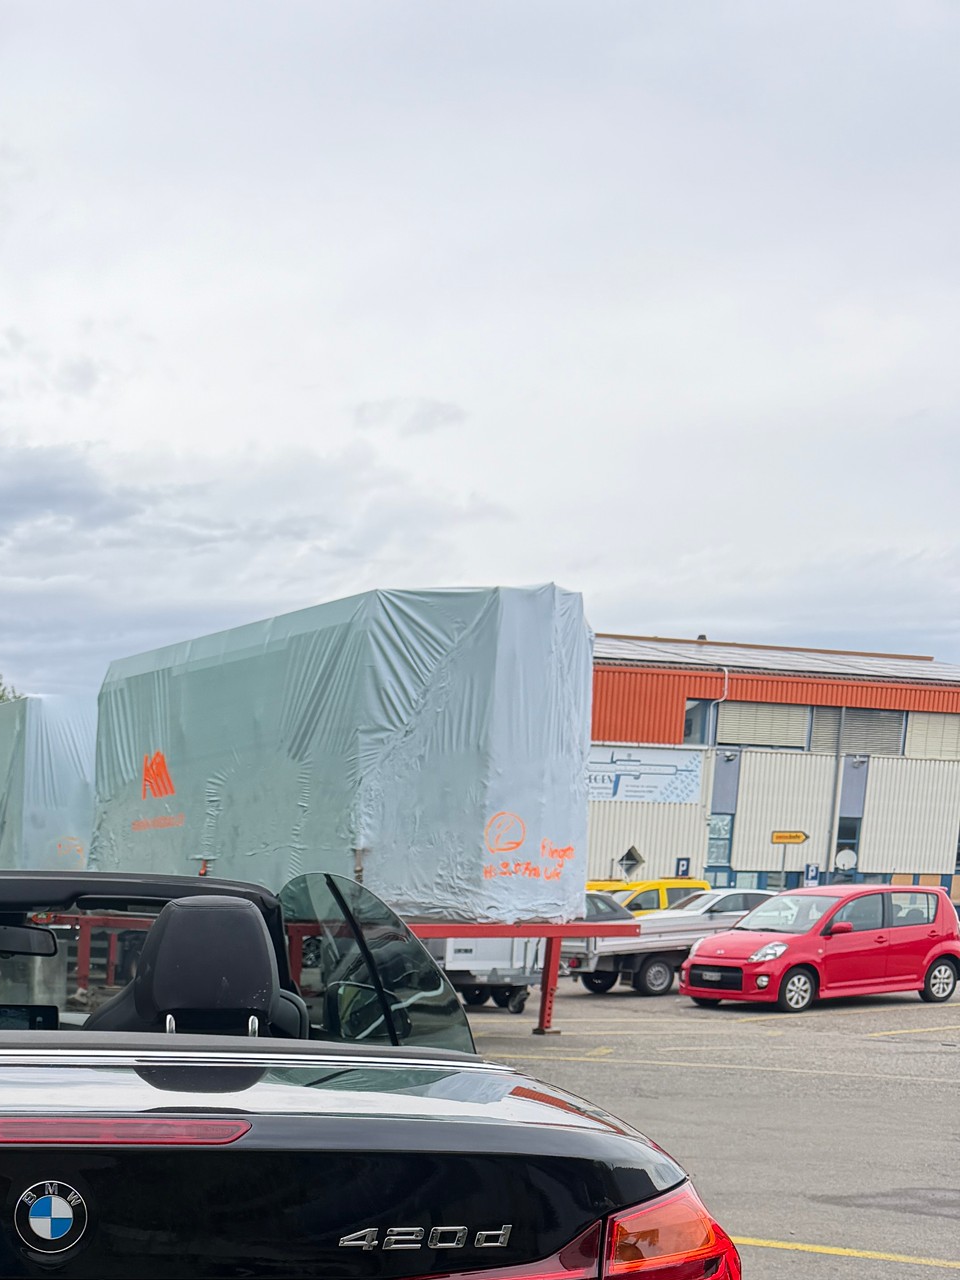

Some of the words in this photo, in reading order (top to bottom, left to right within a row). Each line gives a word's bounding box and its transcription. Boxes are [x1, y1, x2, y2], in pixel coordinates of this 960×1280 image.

[679, 860, 688, 875] P
[808, 866, 817, 879] P
[22, 1183, 82, 1207] BMW
[339, 1214, 513, 1251] 420d
